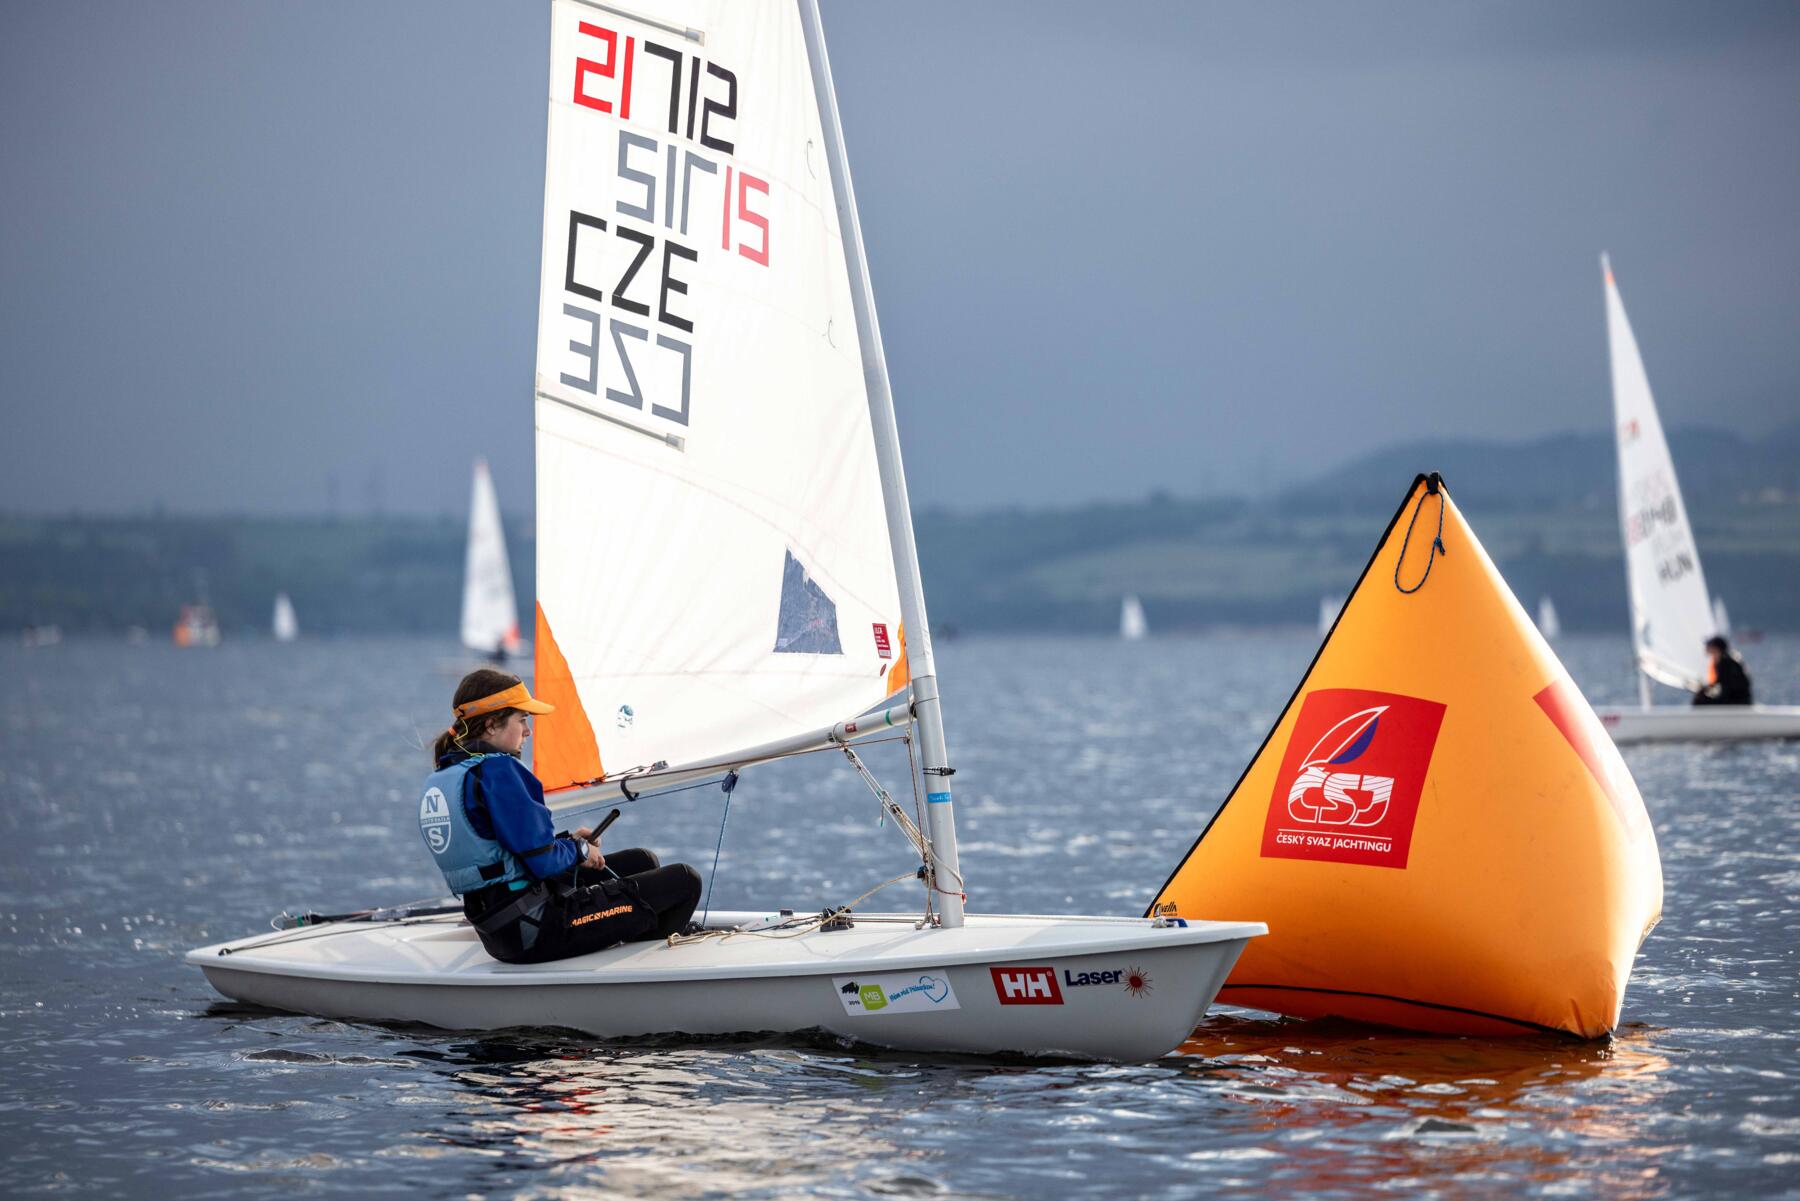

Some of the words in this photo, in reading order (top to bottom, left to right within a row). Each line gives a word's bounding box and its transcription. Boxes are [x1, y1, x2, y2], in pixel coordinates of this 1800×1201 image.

[573, 21, 737, 156] 21712
[565, 209, 698, 333] CZE
[425, 794, 441, 814] N
[1288, 766, 1394, 827] ČSJ
[428, 827, 445, 846] S
[1276, 832, 1304, 845] ČESKÝ
[1306, 835, 1331, 847] SVAZ
[1333, 838, 1392, 853] JACHTINGU
[601, 905, 633, 919] MARINE
[1000, 973, 1053, 998] HH
[1064, 969, 1122, 987] Laser
